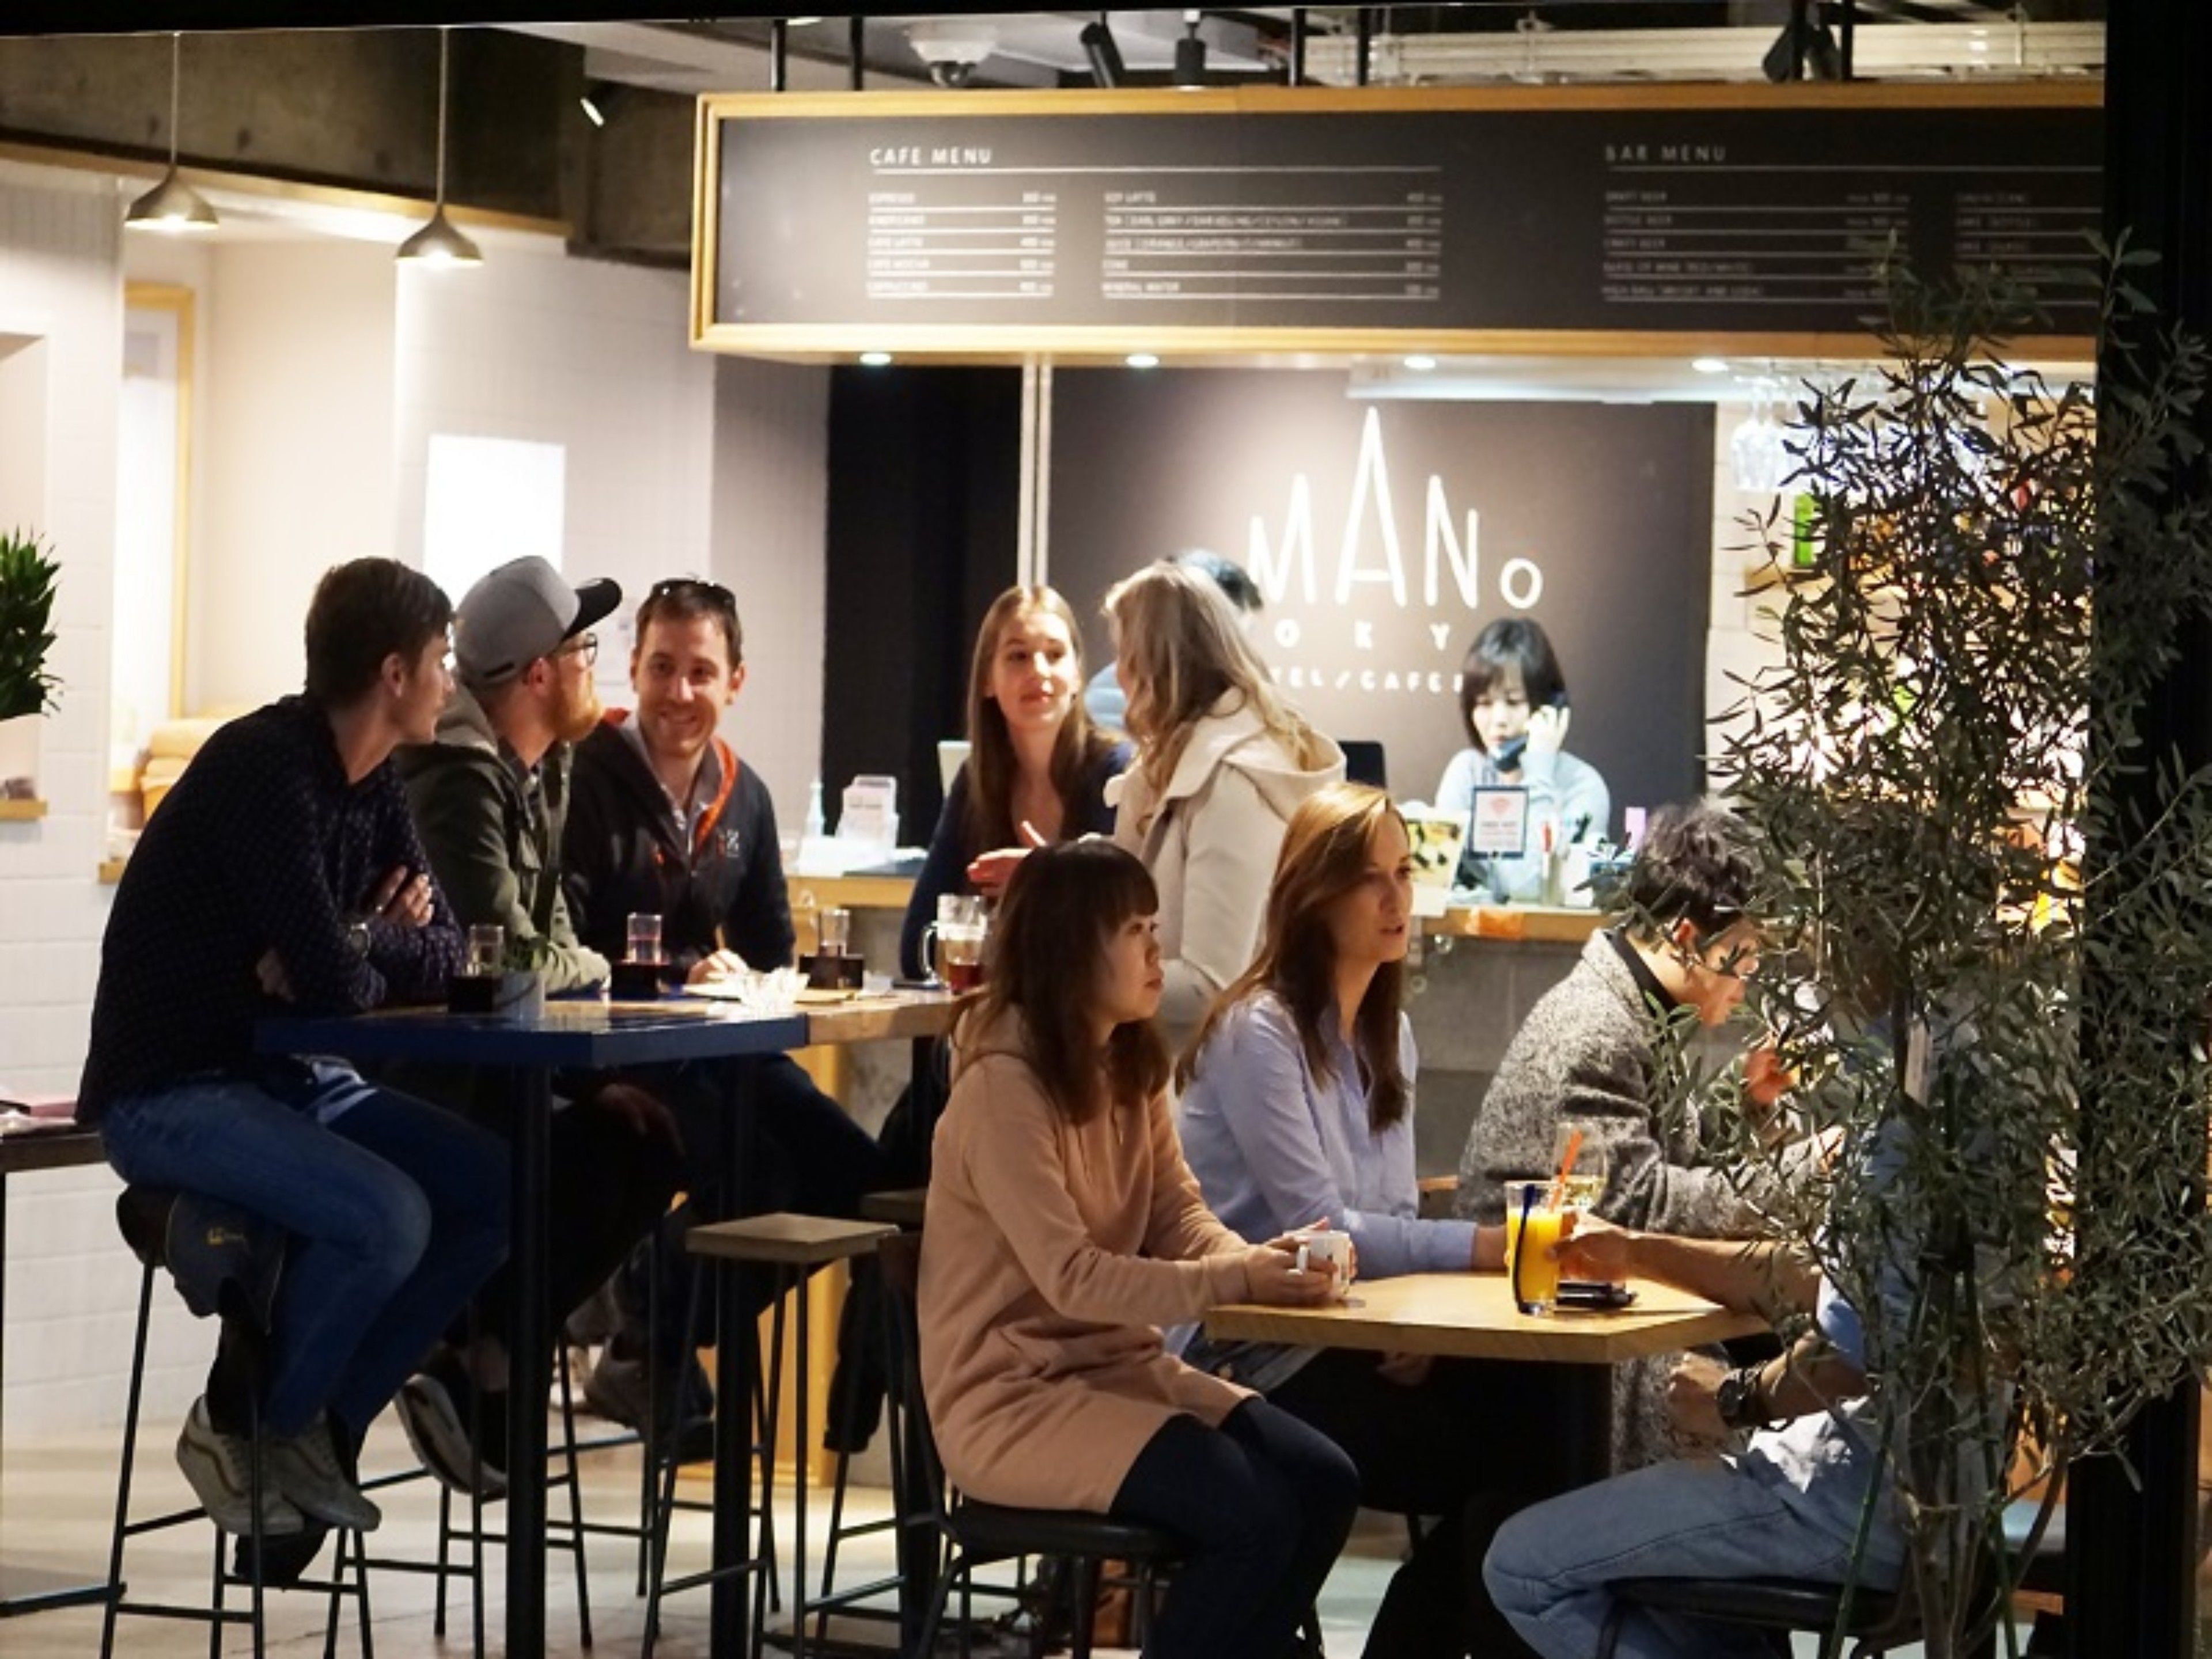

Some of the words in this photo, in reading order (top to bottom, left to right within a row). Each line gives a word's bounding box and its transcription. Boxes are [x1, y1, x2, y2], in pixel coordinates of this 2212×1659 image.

[870, 147, 921, 165] CAFE
[931, 146, 992, 165] MENU
[1605, 145, 1648, 161] BAR
[1661, 145, 1727, 162] MENU
